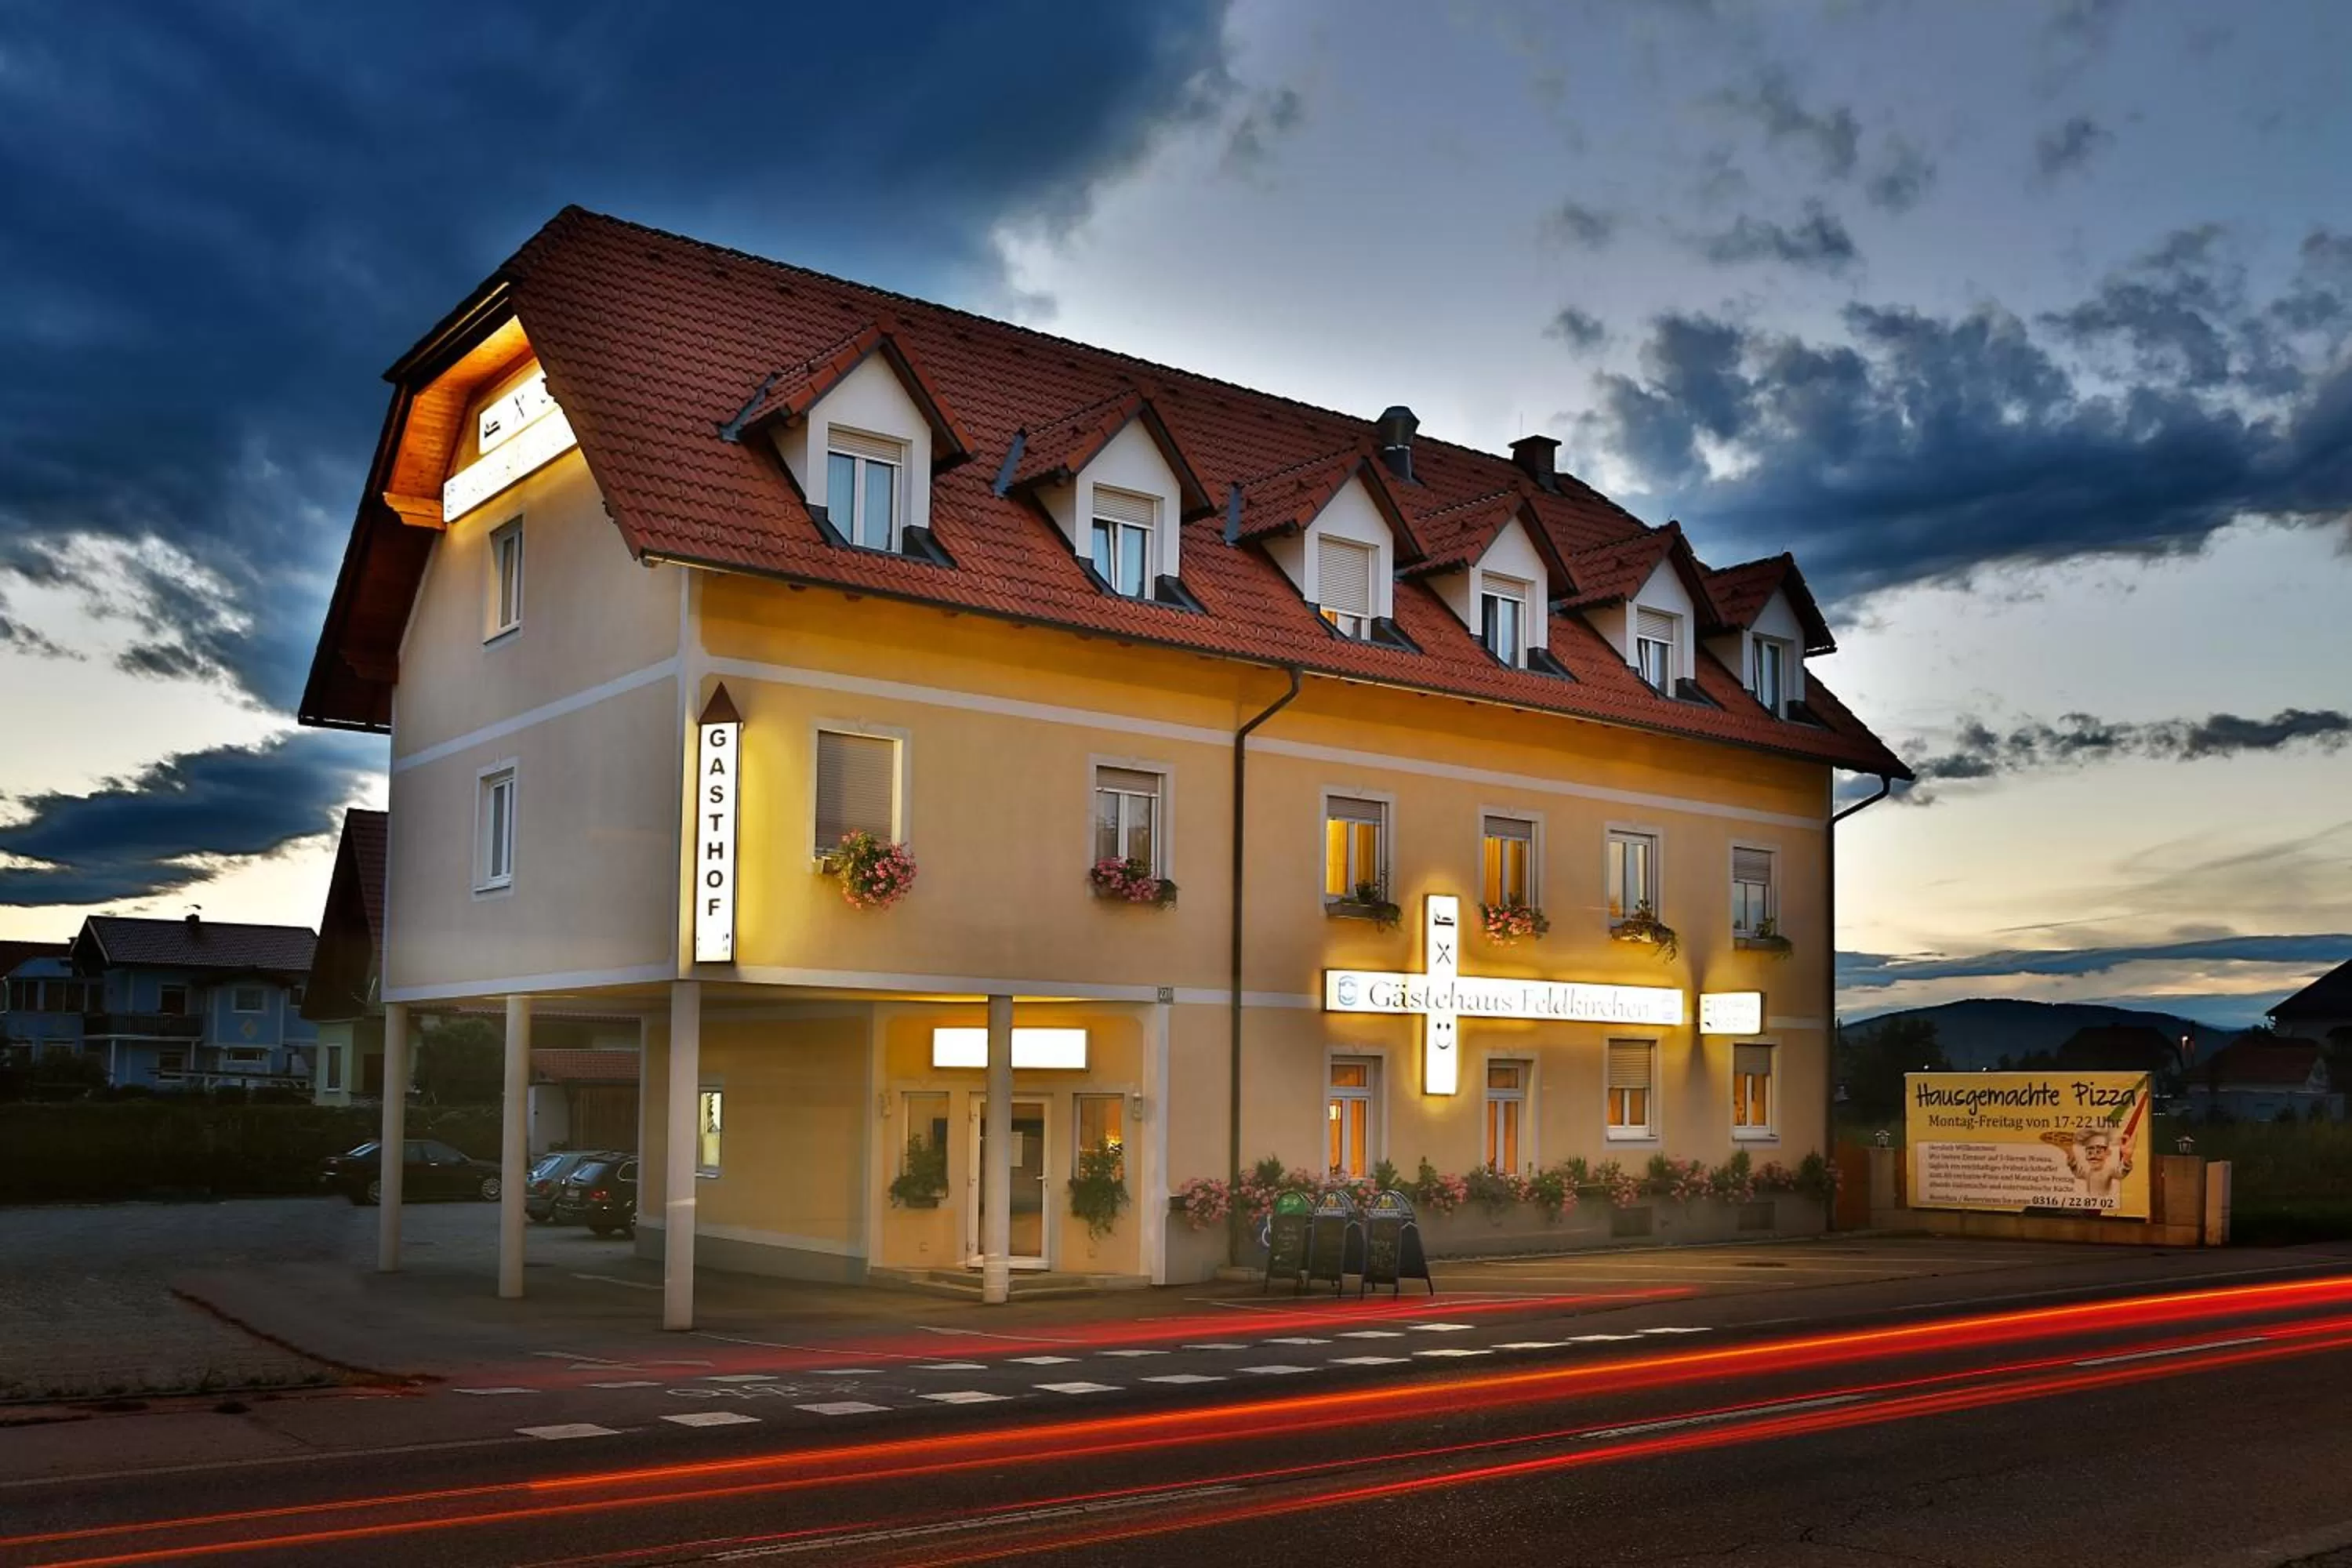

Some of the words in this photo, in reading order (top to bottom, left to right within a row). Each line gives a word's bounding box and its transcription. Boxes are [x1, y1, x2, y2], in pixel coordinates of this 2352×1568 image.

[706, 729, 727, 916] GASTHOF
[1369, 980, 1512, 1012] Gästehaus
[1915, 1082, 2060, 1116] Hausgemachte
[2071, 1081, 2136, 1107] Pizza
[1929, 1114, 2024, 1131] Montag-Freitag
[2026, 1118, 2049, 1128] von
[2055, 1116, 2092, 1128] 17-22
[2097, 1116, 2122, 1128] Uhr
[2032, 1196, 2058, 1205] 0316
[2069, 1197, 2082, 1207] 22
[2084, 1197, 2097, 1207] 87
[2100, 1199, 2114, 1208] 02
